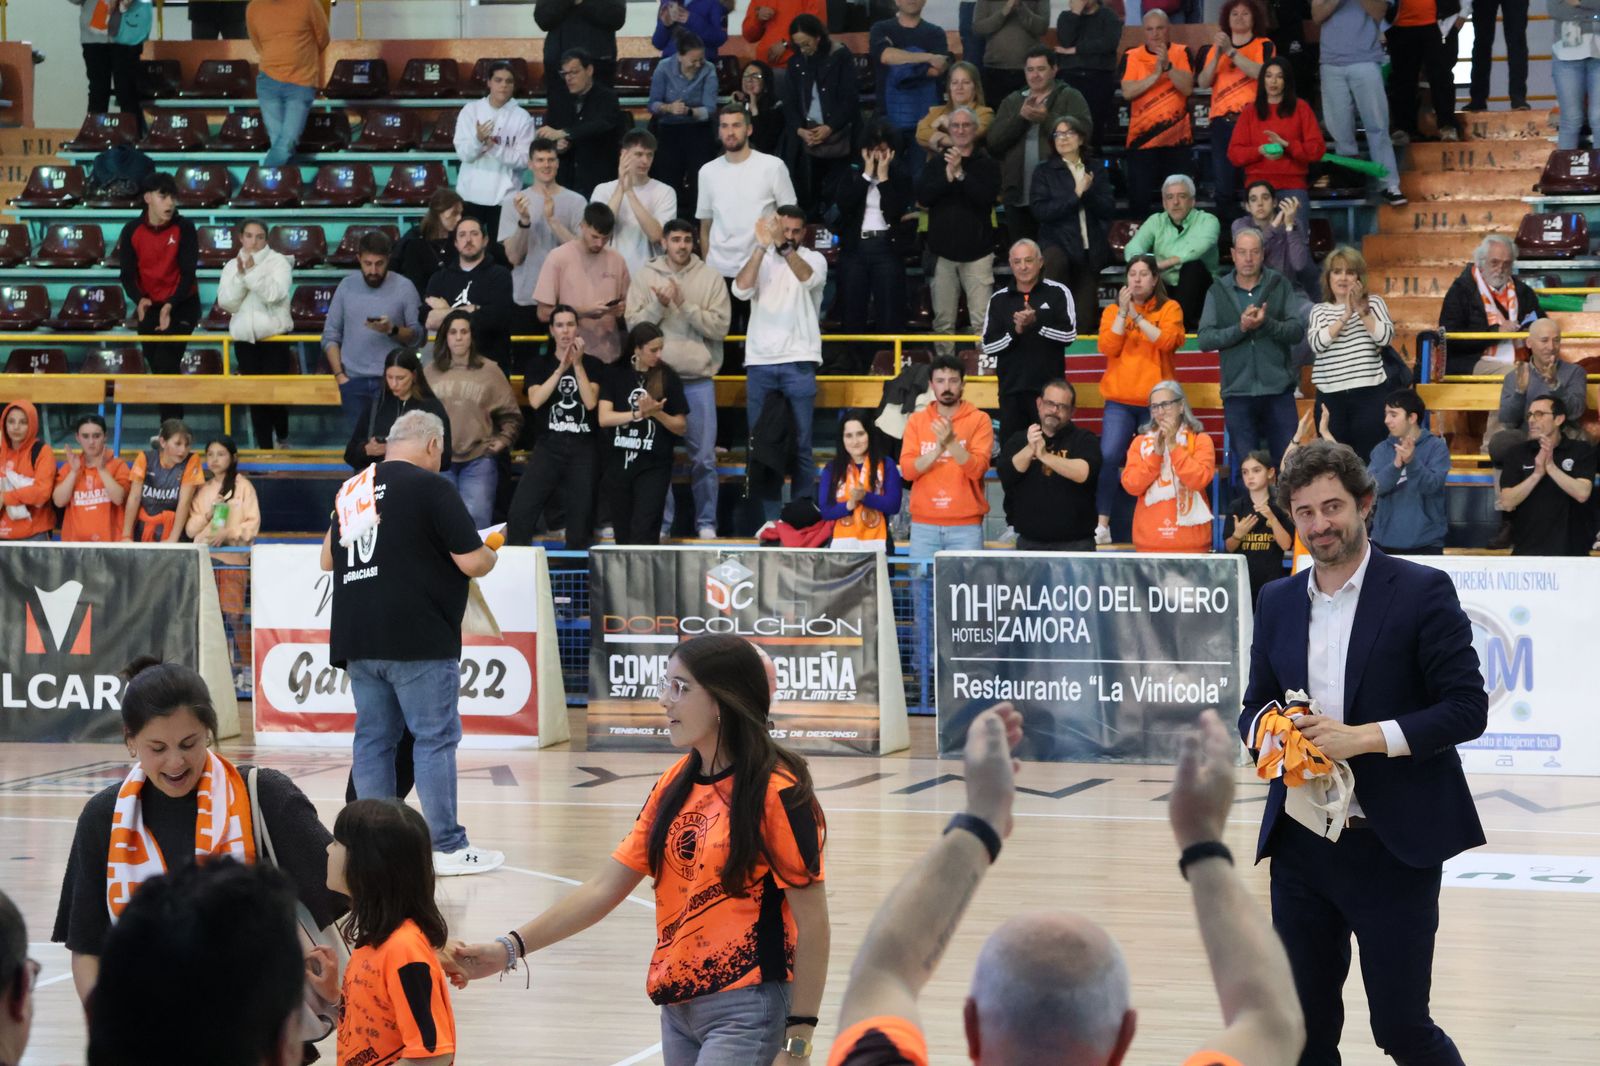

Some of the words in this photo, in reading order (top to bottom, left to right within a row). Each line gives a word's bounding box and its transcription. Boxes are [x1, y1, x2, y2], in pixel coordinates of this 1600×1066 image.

[217, 65, 232, 74] 58
[104, 117, 119, 127] 60
[385, 117, 401, 127] 52
[1570, 152, 1590, 166] 24
[194, 171, 210, 181] 56
[265, 171, 282, 181] 54
[338, 168, 354, 180] 52
[411, 168, 427, 178] 50
[1543, 215, 1563, 230] 24
[67, 229, 83, 240] 58
[289, 230, 308, 241] 52
[11, 289, 28, 300] 58
[314, 289, 331, 300] 50
[30, 353, 49, 368] 56
[1497, 571, 1559, 591] INDUSTRIAL
[996, 584, 1092, 612] PALACIO
[1099, 586, 1142, 612] DEL
[1148, 586, 1230, 614] DUERO
[951, 626, 994, 643] HOTELS
[996, 616, 1091, 643] ZAMORA
[772, 650, 857, 690] SUEÑA
[609, 684, 637, 698] SIN
[952, 673, 1083, 700] Restaurante
[774, 689, 798, 701] SIN
[609, 727, 655, 736] TENEMOS
[806, 730, 858, 739] DESCANSO
